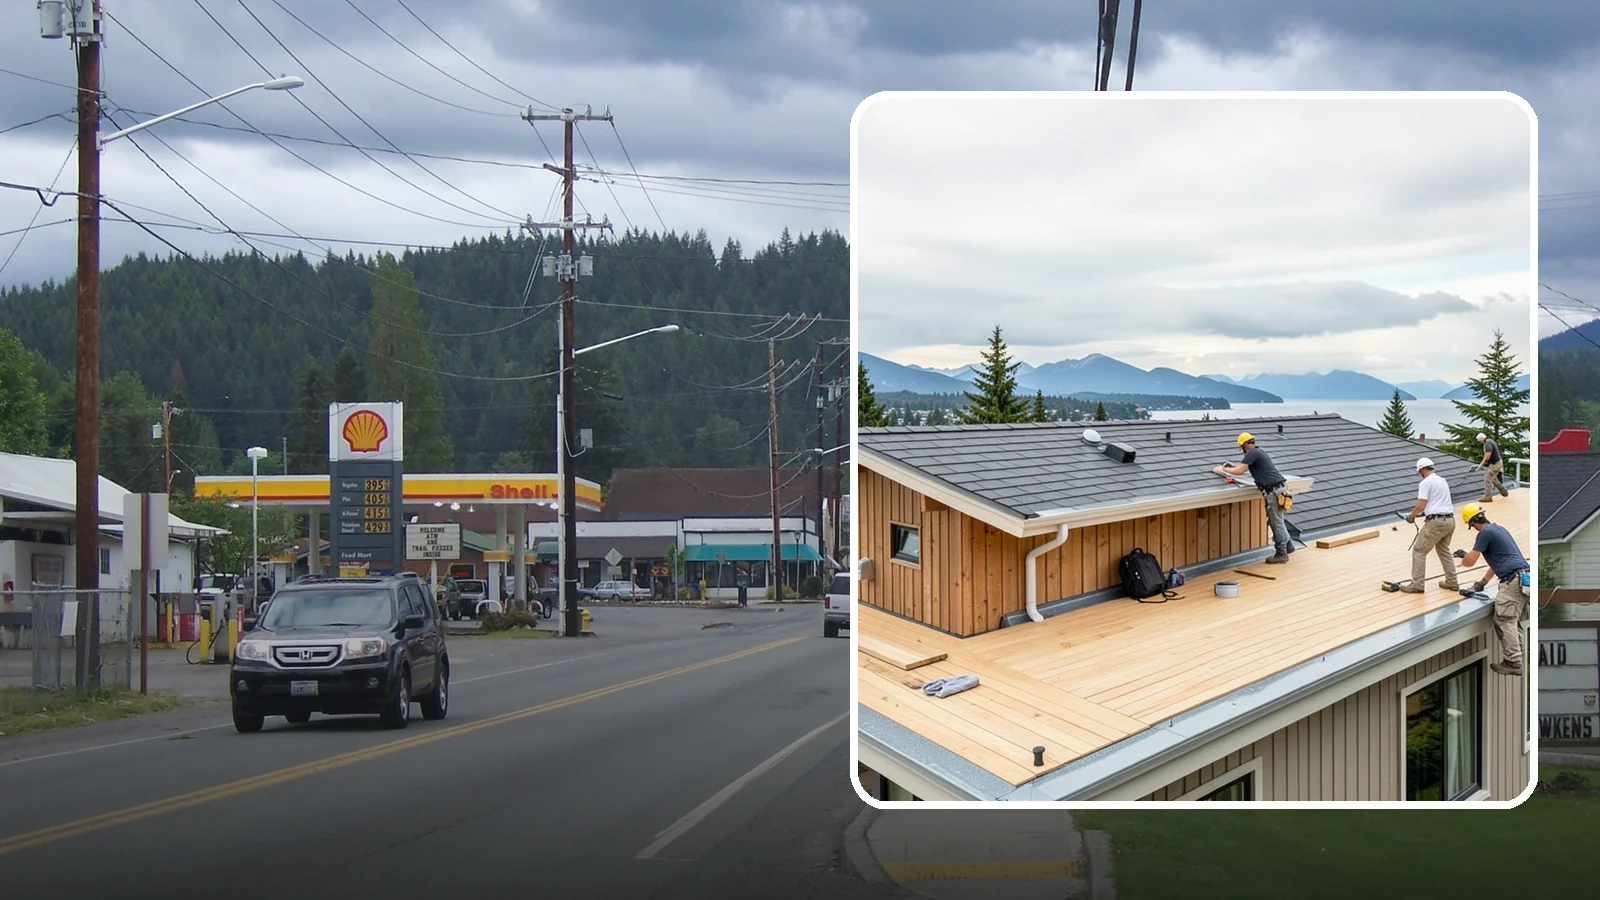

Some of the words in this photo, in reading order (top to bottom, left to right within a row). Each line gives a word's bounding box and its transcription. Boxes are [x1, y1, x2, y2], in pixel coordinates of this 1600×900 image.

[365, 480, 383, 490] 395
[490, 484, 547, 499] Shell
[365, 494, 383, 504] 405
[365, 508, 383, 518] 415
[365, 522, 383, 532] 429
